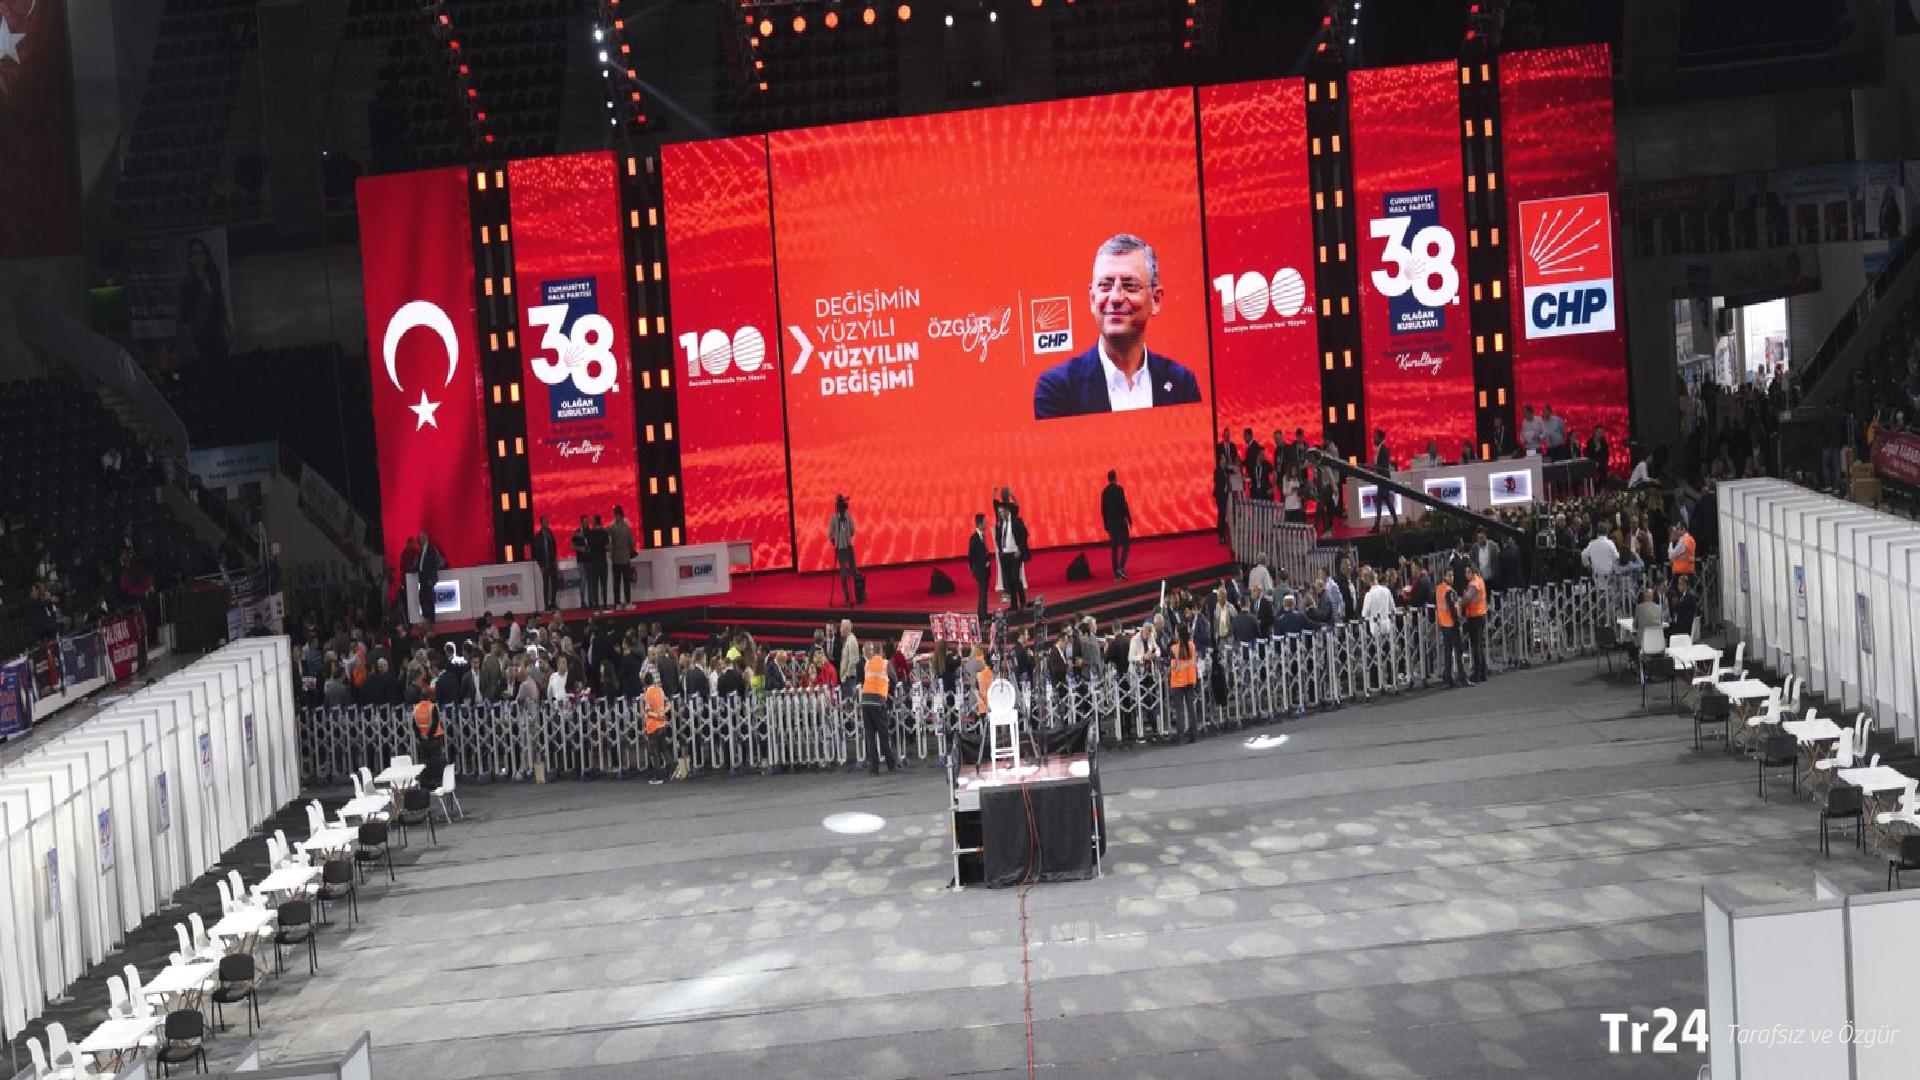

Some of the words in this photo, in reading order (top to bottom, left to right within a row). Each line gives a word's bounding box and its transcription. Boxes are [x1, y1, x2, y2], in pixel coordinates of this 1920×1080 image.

[815, 286, 921, 318] DEĞİŞİMİN
[1531, 287, 1608, 330] CHP
[816, 317, 895, 343] YÜZYILI
[927, 313, 991, 338] ÖZGÜR
[1037, 332, 1069, 349] CHP
[818, 341, 920, 370] YÜZYILIN
[820, 363, 915, 396] DEĞİŞİMİ
[1442, 486, 1461, 498] CHP
[437, 590, 456, 602] CHP
